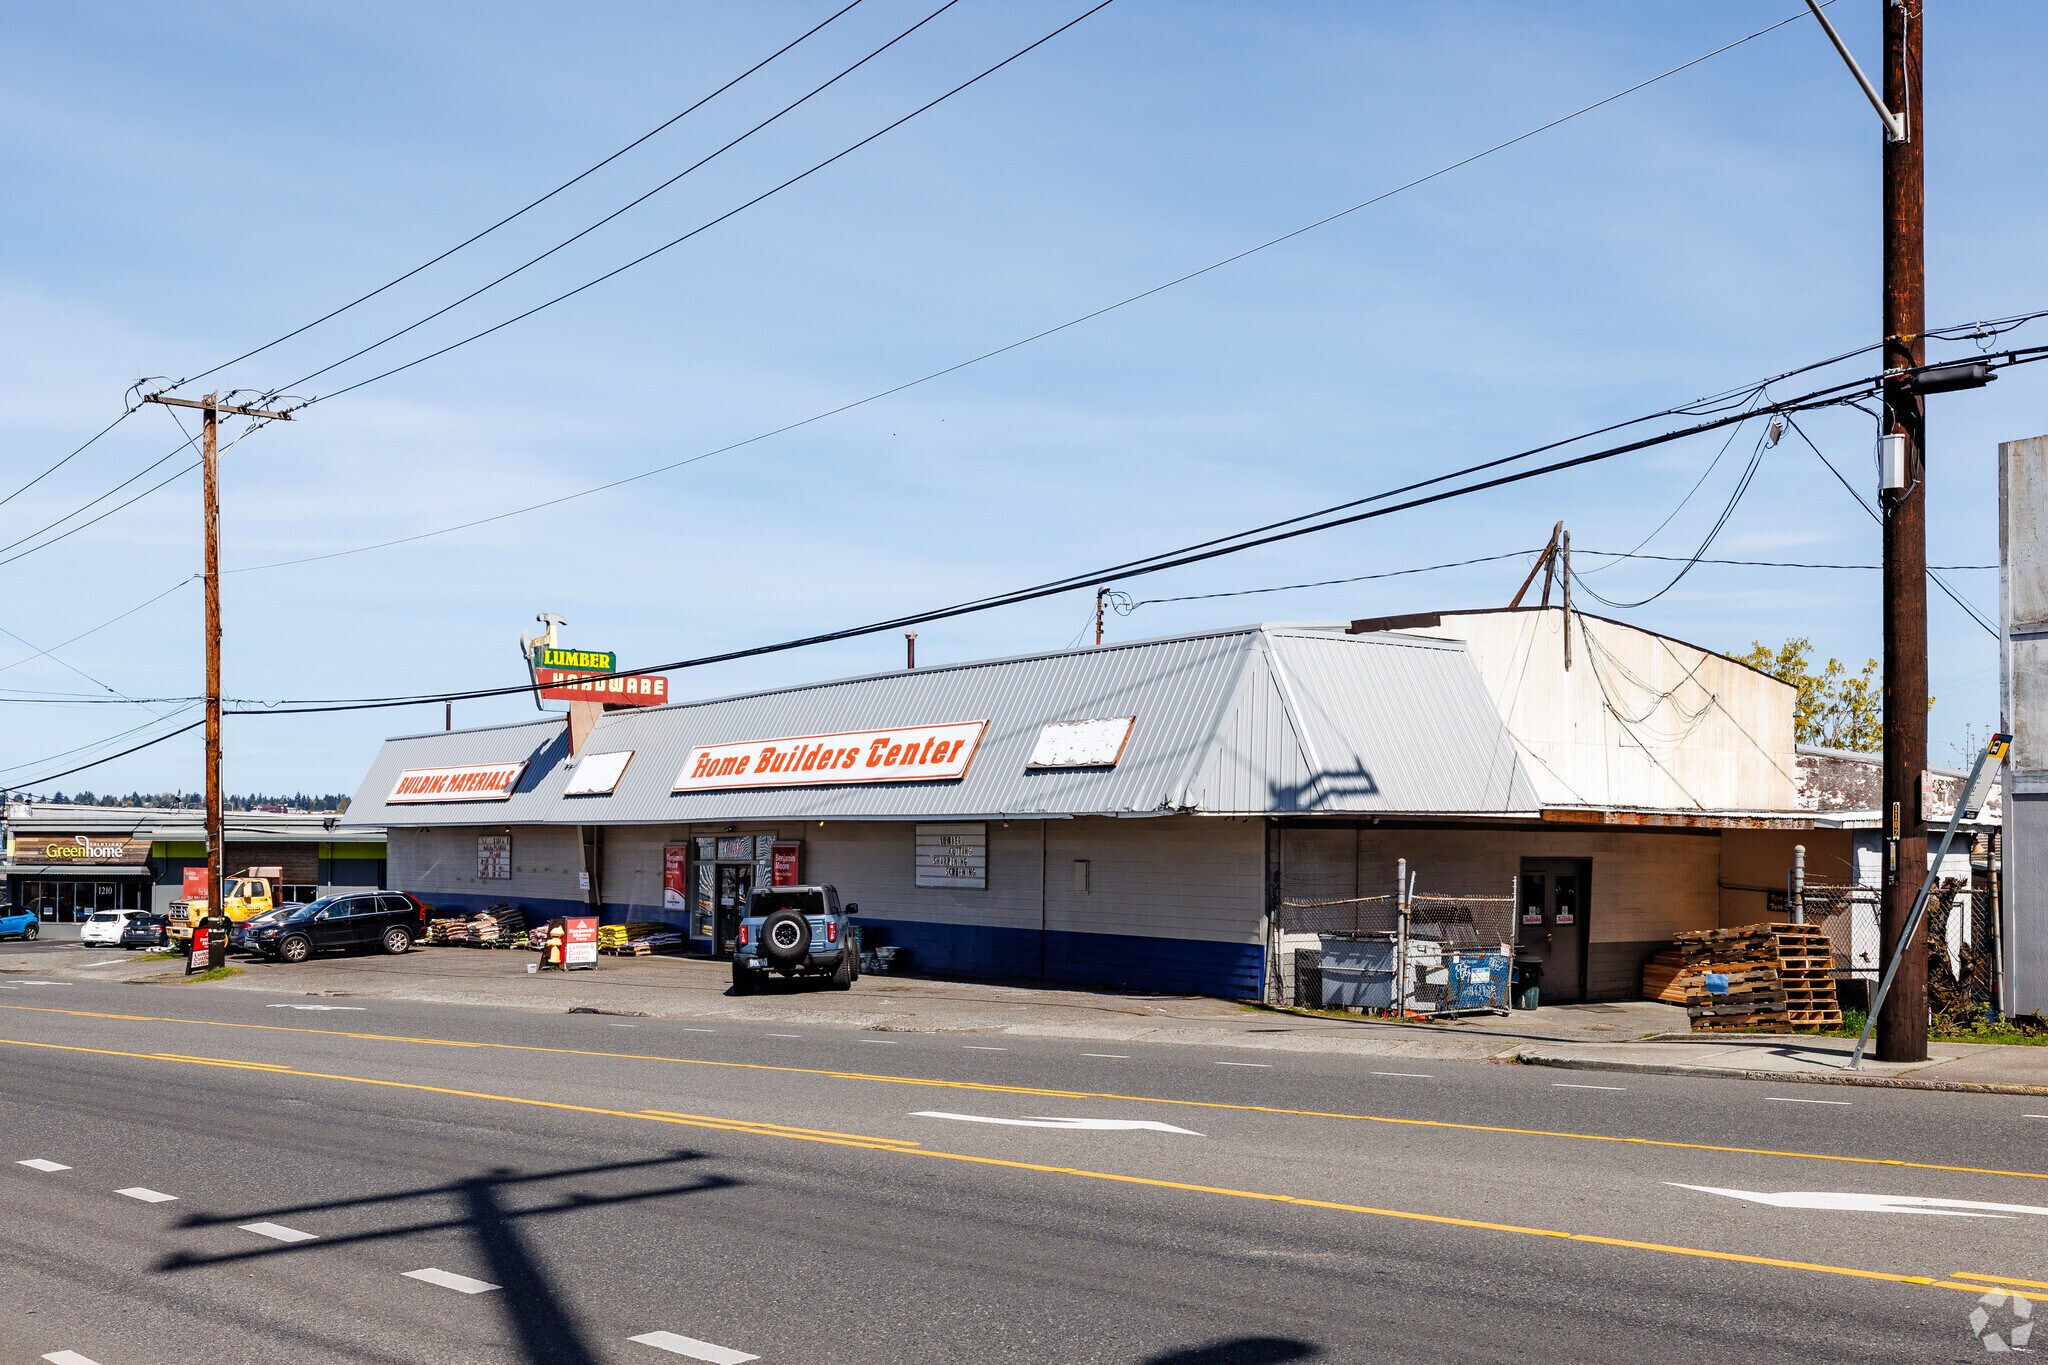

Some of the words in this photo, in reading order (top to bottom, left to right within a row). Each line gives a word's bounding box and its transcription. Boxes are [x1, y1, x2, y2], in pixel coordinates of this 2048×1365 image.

[543, 650, 611, 669] LUMBER
[552, 672, 665, 696] HARDWARE
[690, 751, 751, 779] Home
[753, 743, 861, 774] Builders
[865, 736, 966, 768] Center
[395, 774, 450, 795] BUILDING
[444, 770, 516, 793] MATERIALS
[775, 853, 796, 864] Benjamin
[775, 861, 790, 870] Moore
[98, 886, 113, 895] 1210
[568, 928, 595, 936] Benjamin
